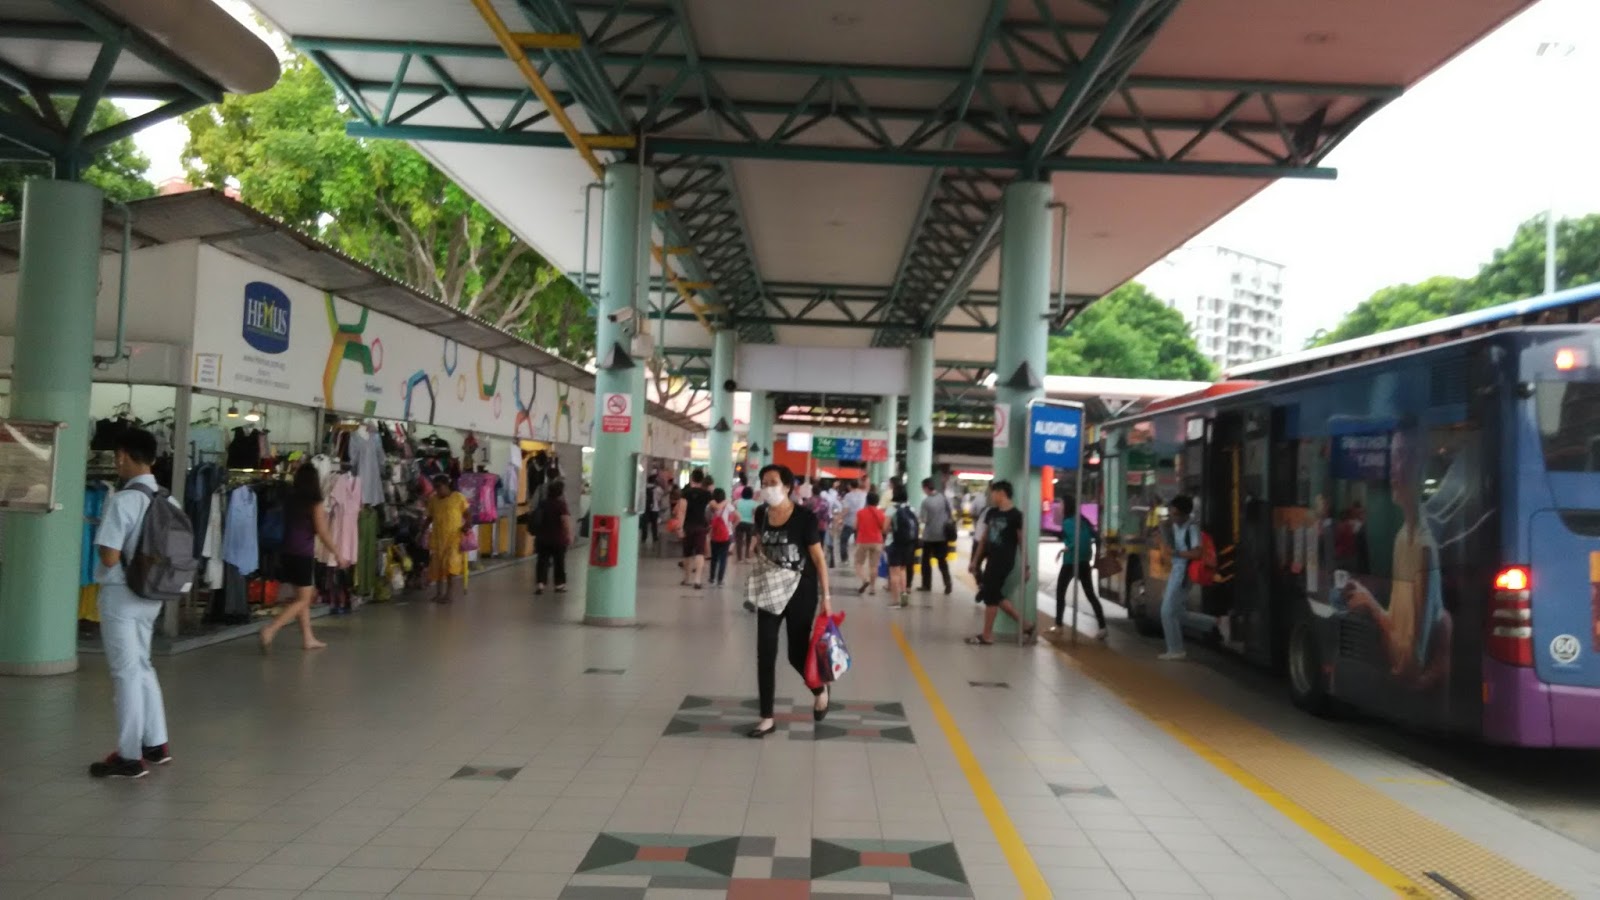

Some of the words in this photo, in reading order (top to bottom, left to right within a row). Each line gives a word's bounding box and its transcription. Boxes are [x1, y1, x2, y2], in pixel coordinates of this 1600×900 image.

[247, 297, 287, 335] HEMUS
[1034, 420, 1077, 438] ALIGHTING
[1045, 439, 1066, 454] ONLY
[1555, 639, 1575, 654] 60
